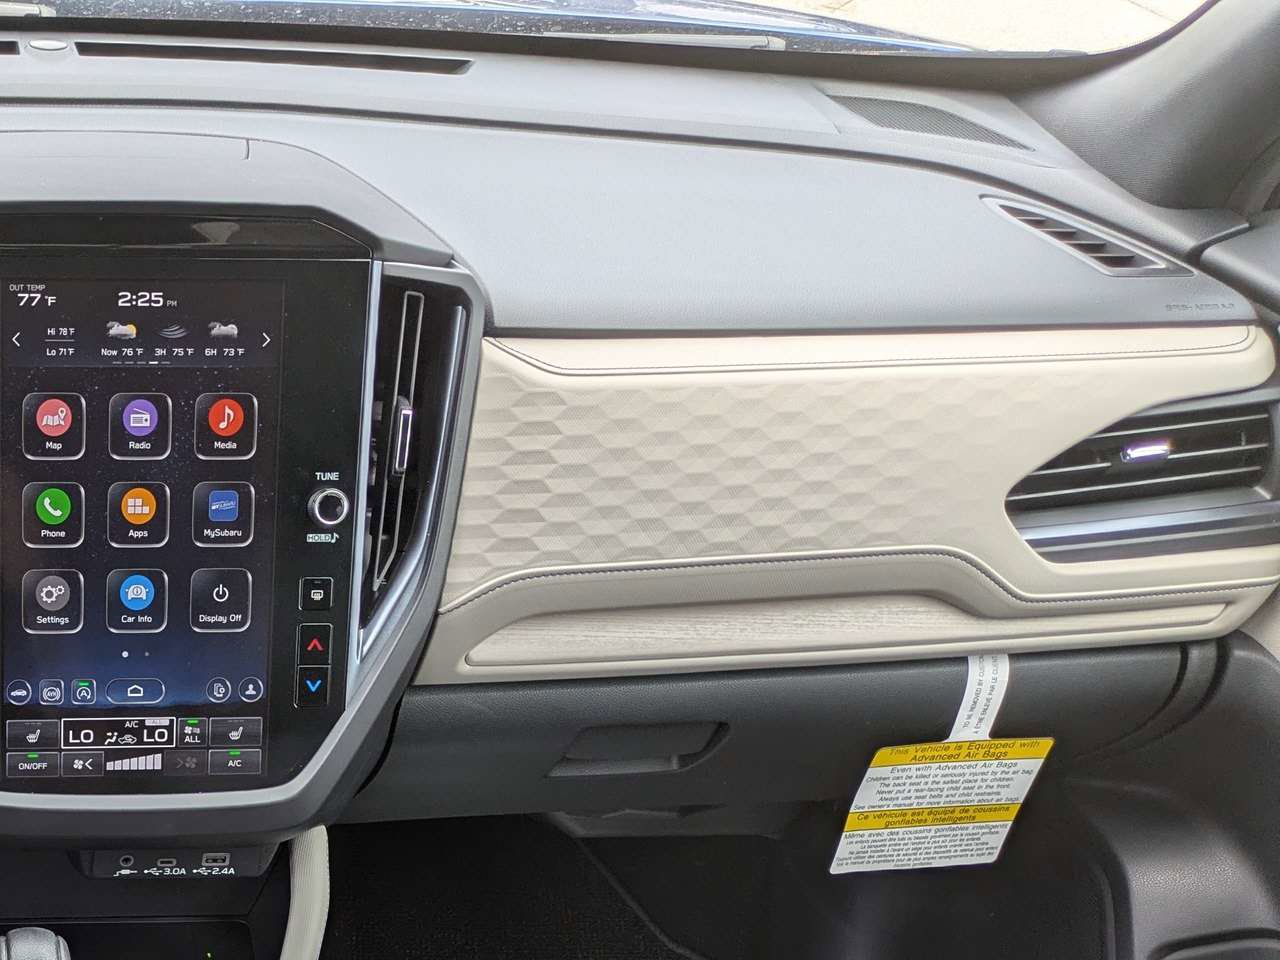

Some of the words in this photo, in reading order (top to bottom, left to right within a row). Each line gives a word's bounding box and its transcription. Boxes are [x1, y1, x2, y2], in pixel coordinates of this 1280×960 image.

[17, 293, 42, 307] 77
[118, 291, 164, 308] 2:25
[166, 299, 178, 308] PM
[46, 348, 56, 356] Lo
[46, 441, 62, 452] Map
[128, 440, 152, 450] Radio
[214, 440, 238, 450] Media
[315, 472, 340, 480] TUNE
[40, 528, 66, 538] Phone
[128, 528, 149, 540] Apps
[204, 528, 242, 538] MySubaru
[36, 614, 70, 625] Settings
[121, 614, 134, 624] Car
[137, 614, 152, 624] Info
[199, 614, 226, 624] Display
[229, 614, 242, 623] Off
[70, 730, 94, 743] LO
[144, 728, 168, 742] LO
[914, 744, 950, 753] Vehicle
[967, 742, 1016, 751] Equipped
[1019, 740, 1040, 748] with
[910, 752, 960, 762] Advanced
[963, 751, 979, 759] Air
[982, 750, 1009, 760] Bags
[18, 762, 48, 770] ON/OFF
[228, 760, 242, 768] A/C
[935, 763, 978, 771] Advanced
[996, 762, 1018, 770] Bags
[872, 810, 907, 819] véhicule
[884, 818, 928, 827] gonflables
[930, 815, 976, 824] intelligents
